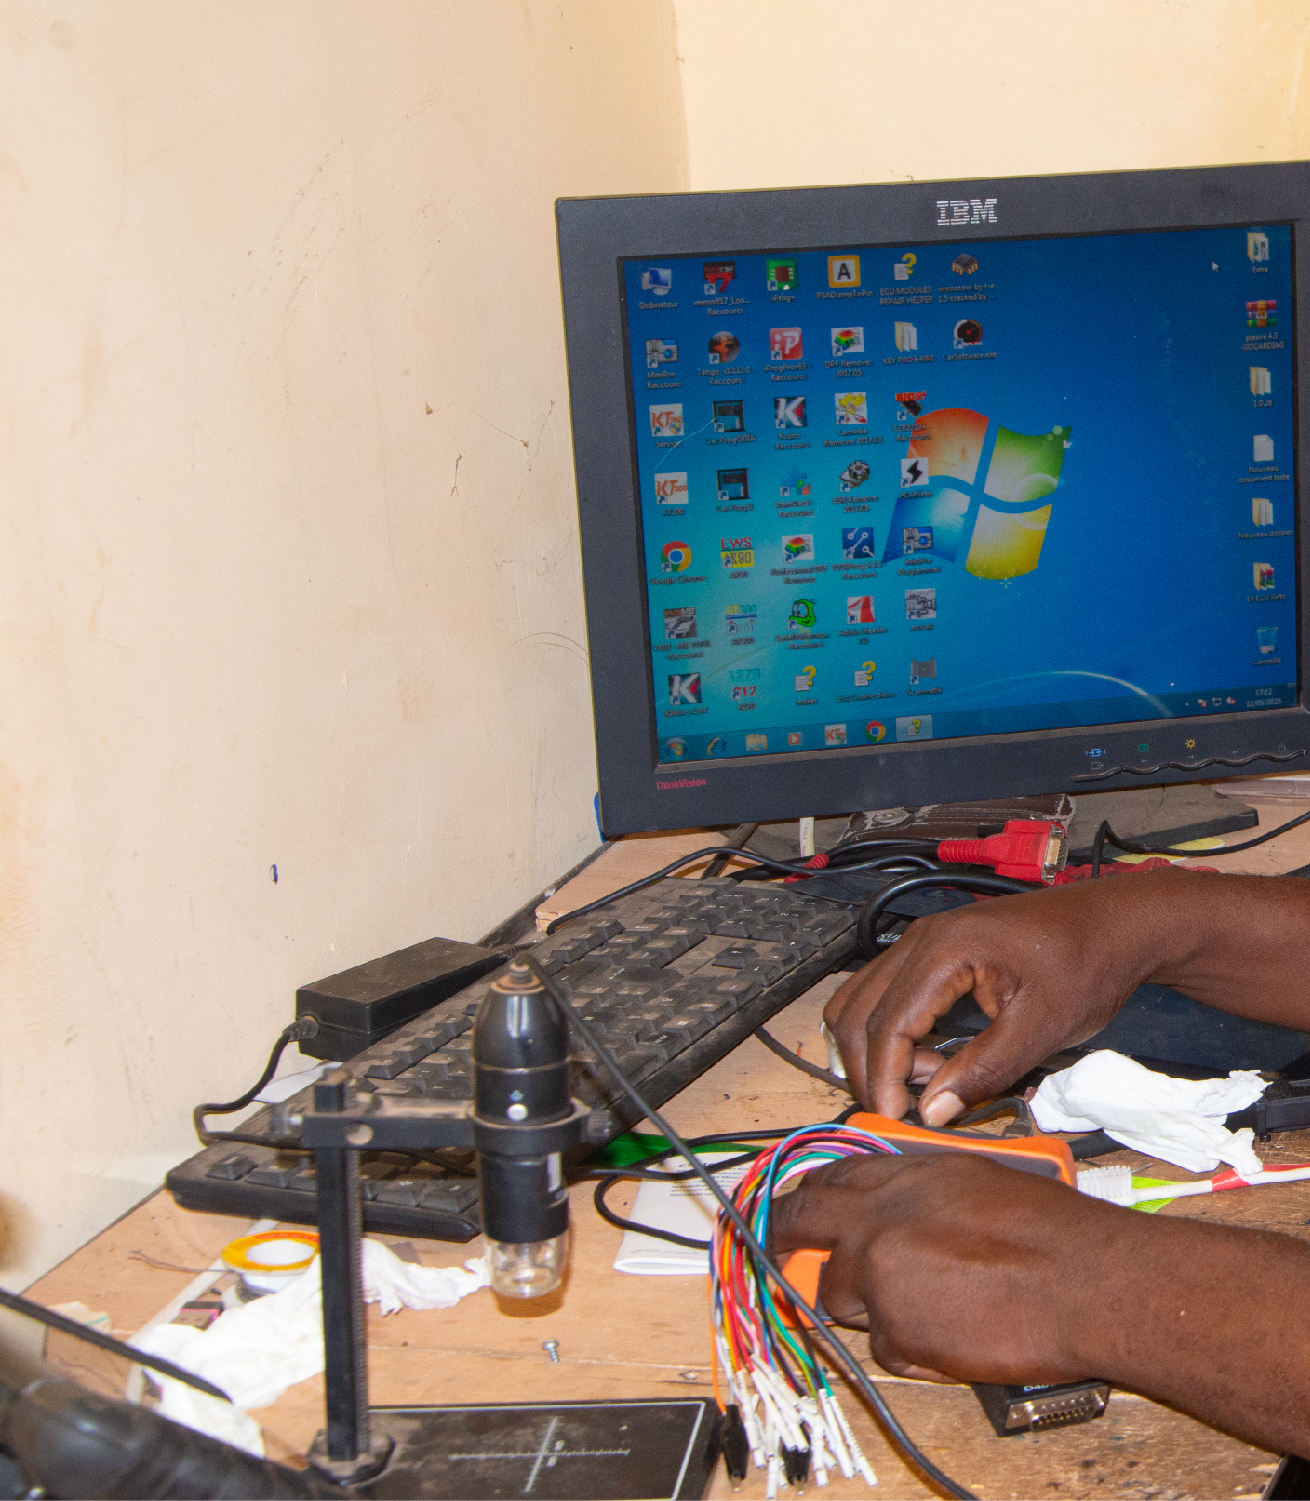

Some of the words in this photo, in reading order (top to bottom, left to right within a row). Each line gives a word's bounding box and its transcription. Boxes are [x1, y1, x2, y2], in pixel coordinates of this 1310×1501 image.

[936, 198, 998, 226] IBM
[639, 301, 678, 309] Ordinateur
[707, 307, 744, 316] Raccourci
[841, 359, 872, 367] Remover
[1238, 475, 1272, 484] document
[721, 536, 752, 550] EWS
[649, 577, 676, 585] Google
[677, 575, 707, 583] Chrome
[655, 778, 707, 791] ThinkVision
